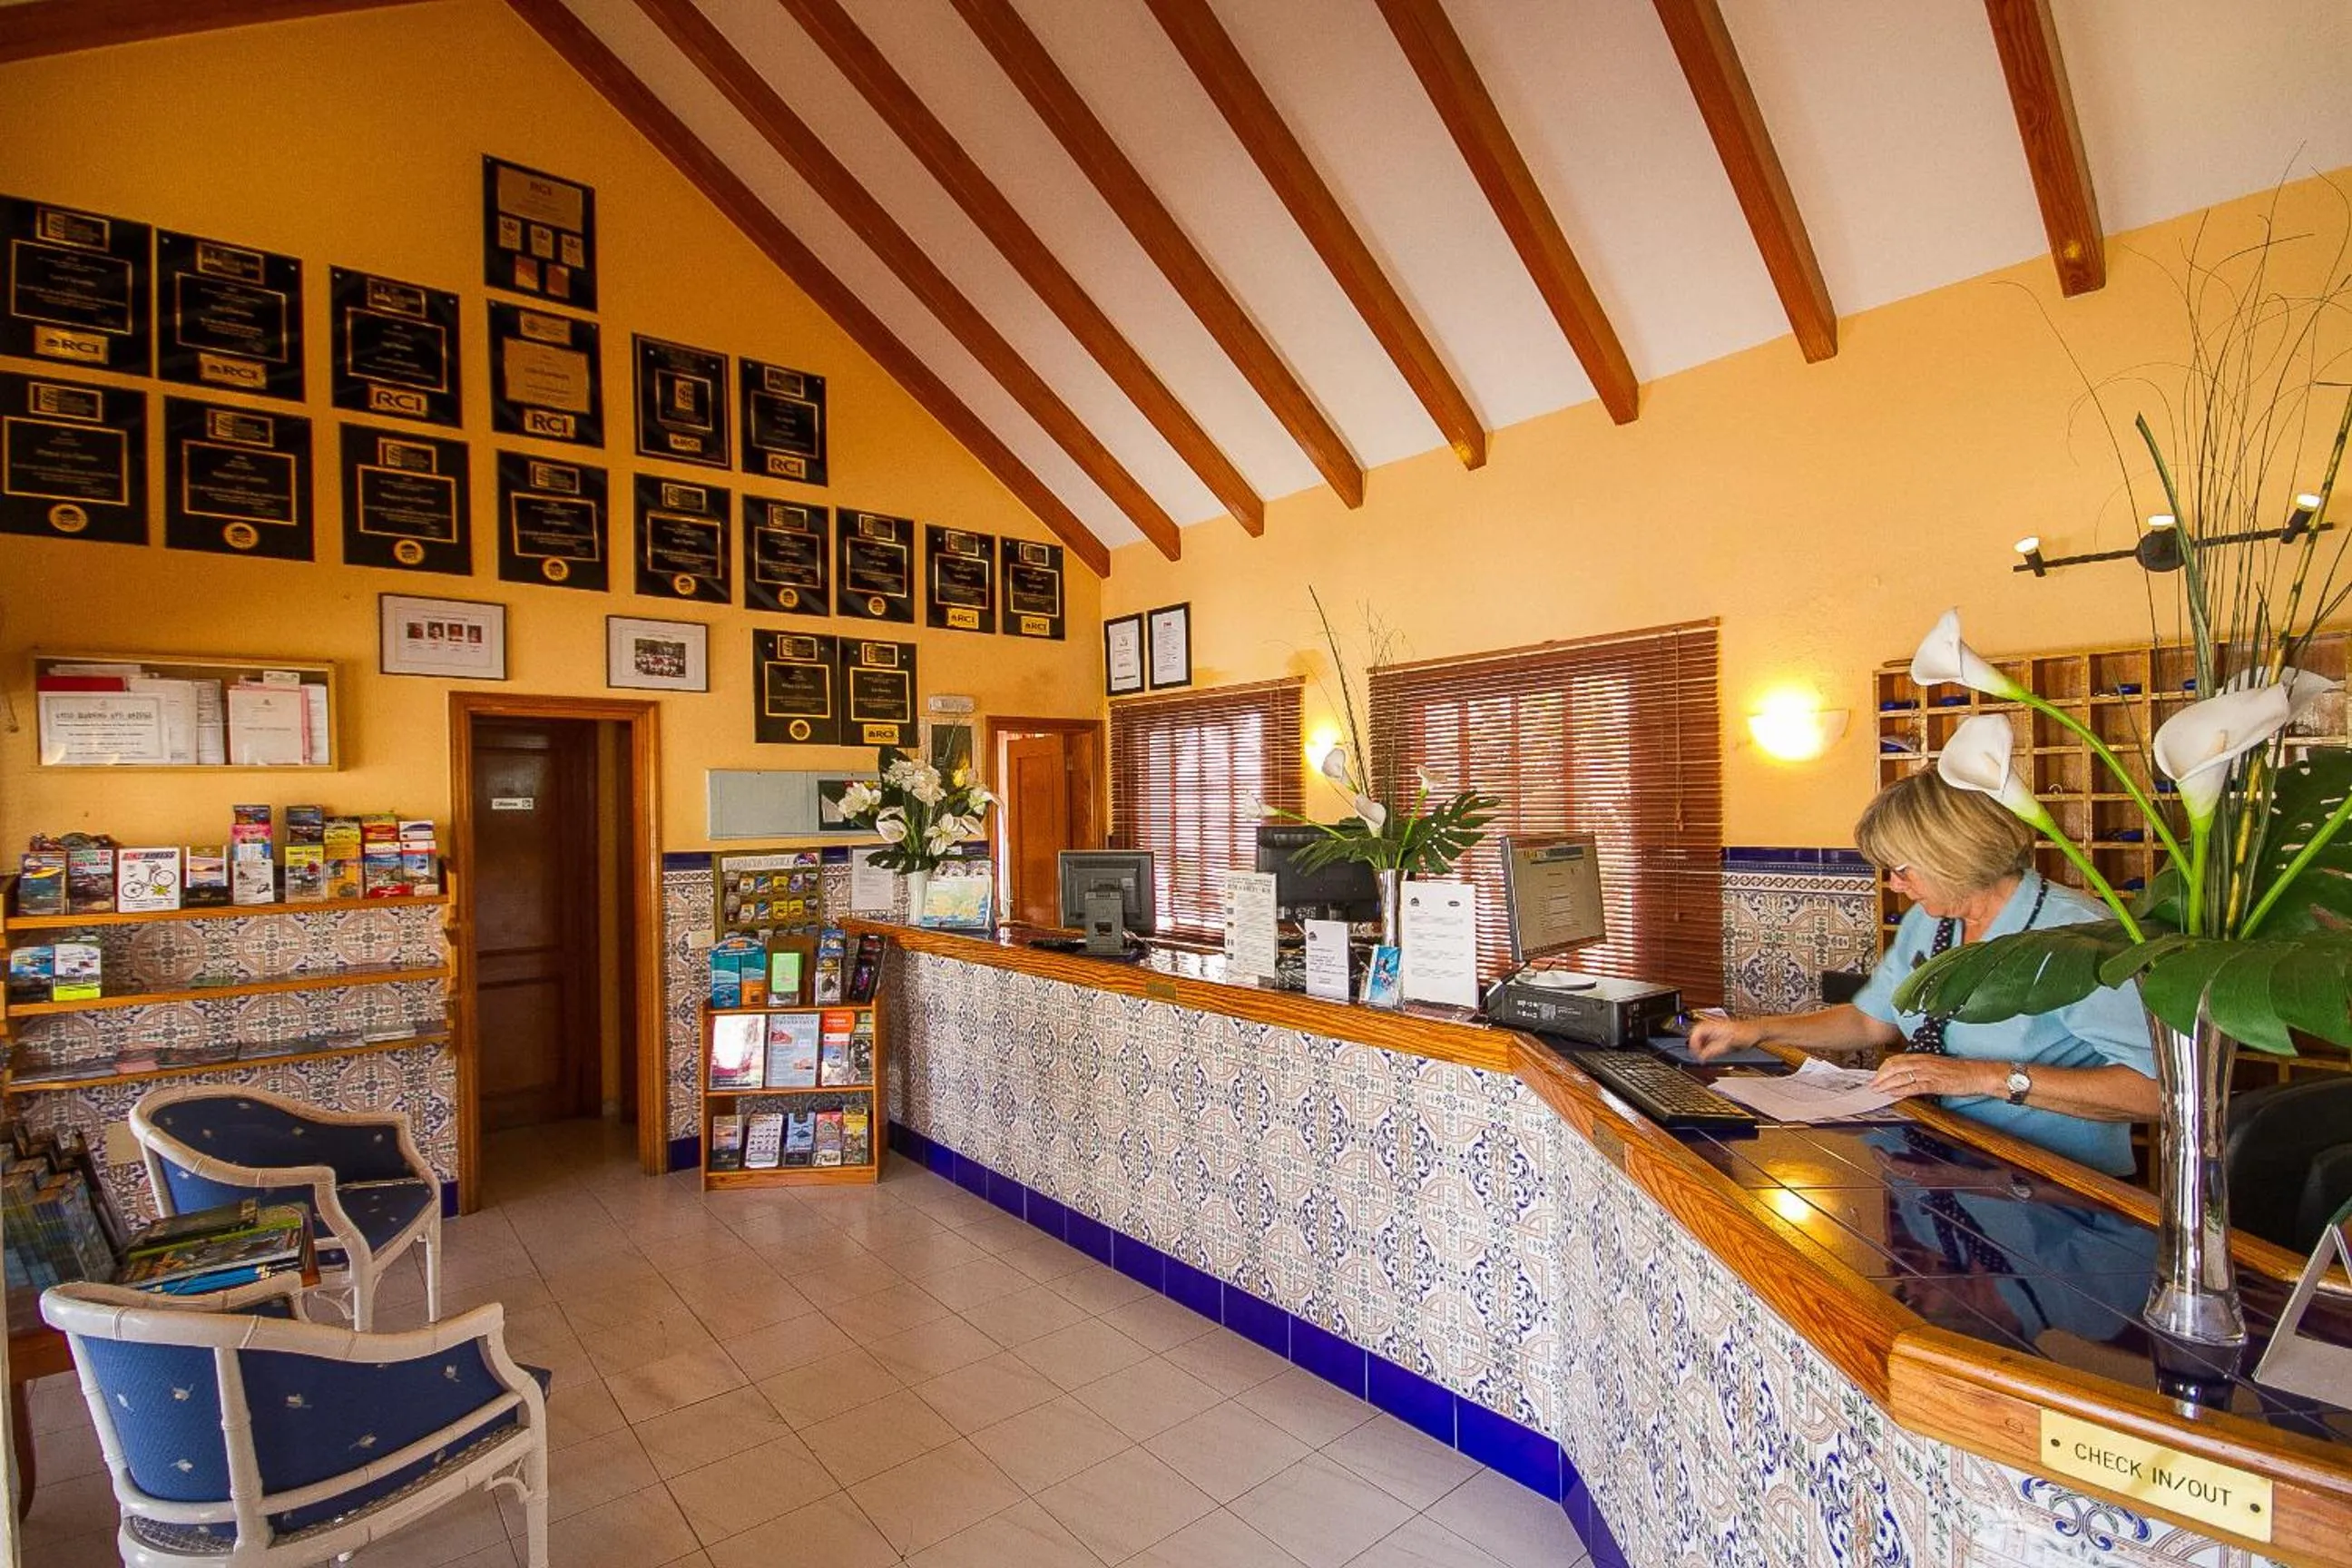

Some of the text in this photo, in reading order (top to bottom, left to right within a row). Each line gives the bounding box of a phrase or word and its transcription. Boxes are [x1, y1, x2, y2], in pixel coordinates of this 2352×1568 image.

[61, 338, 100, 355] RCI
[223, 364, 258, 380] RCI
[376, 390, 422, 411] RCI
[532, 413, 568, 435] RCI
[770, 458, 803, 475] RCI
[957, 613, 975, 623] RCI
[1030, 622, 1047, 632] RCI
[876, 729, 895, 739] RCI
[2073, 1442, 2232, 1506] CHECK IN/OUT
